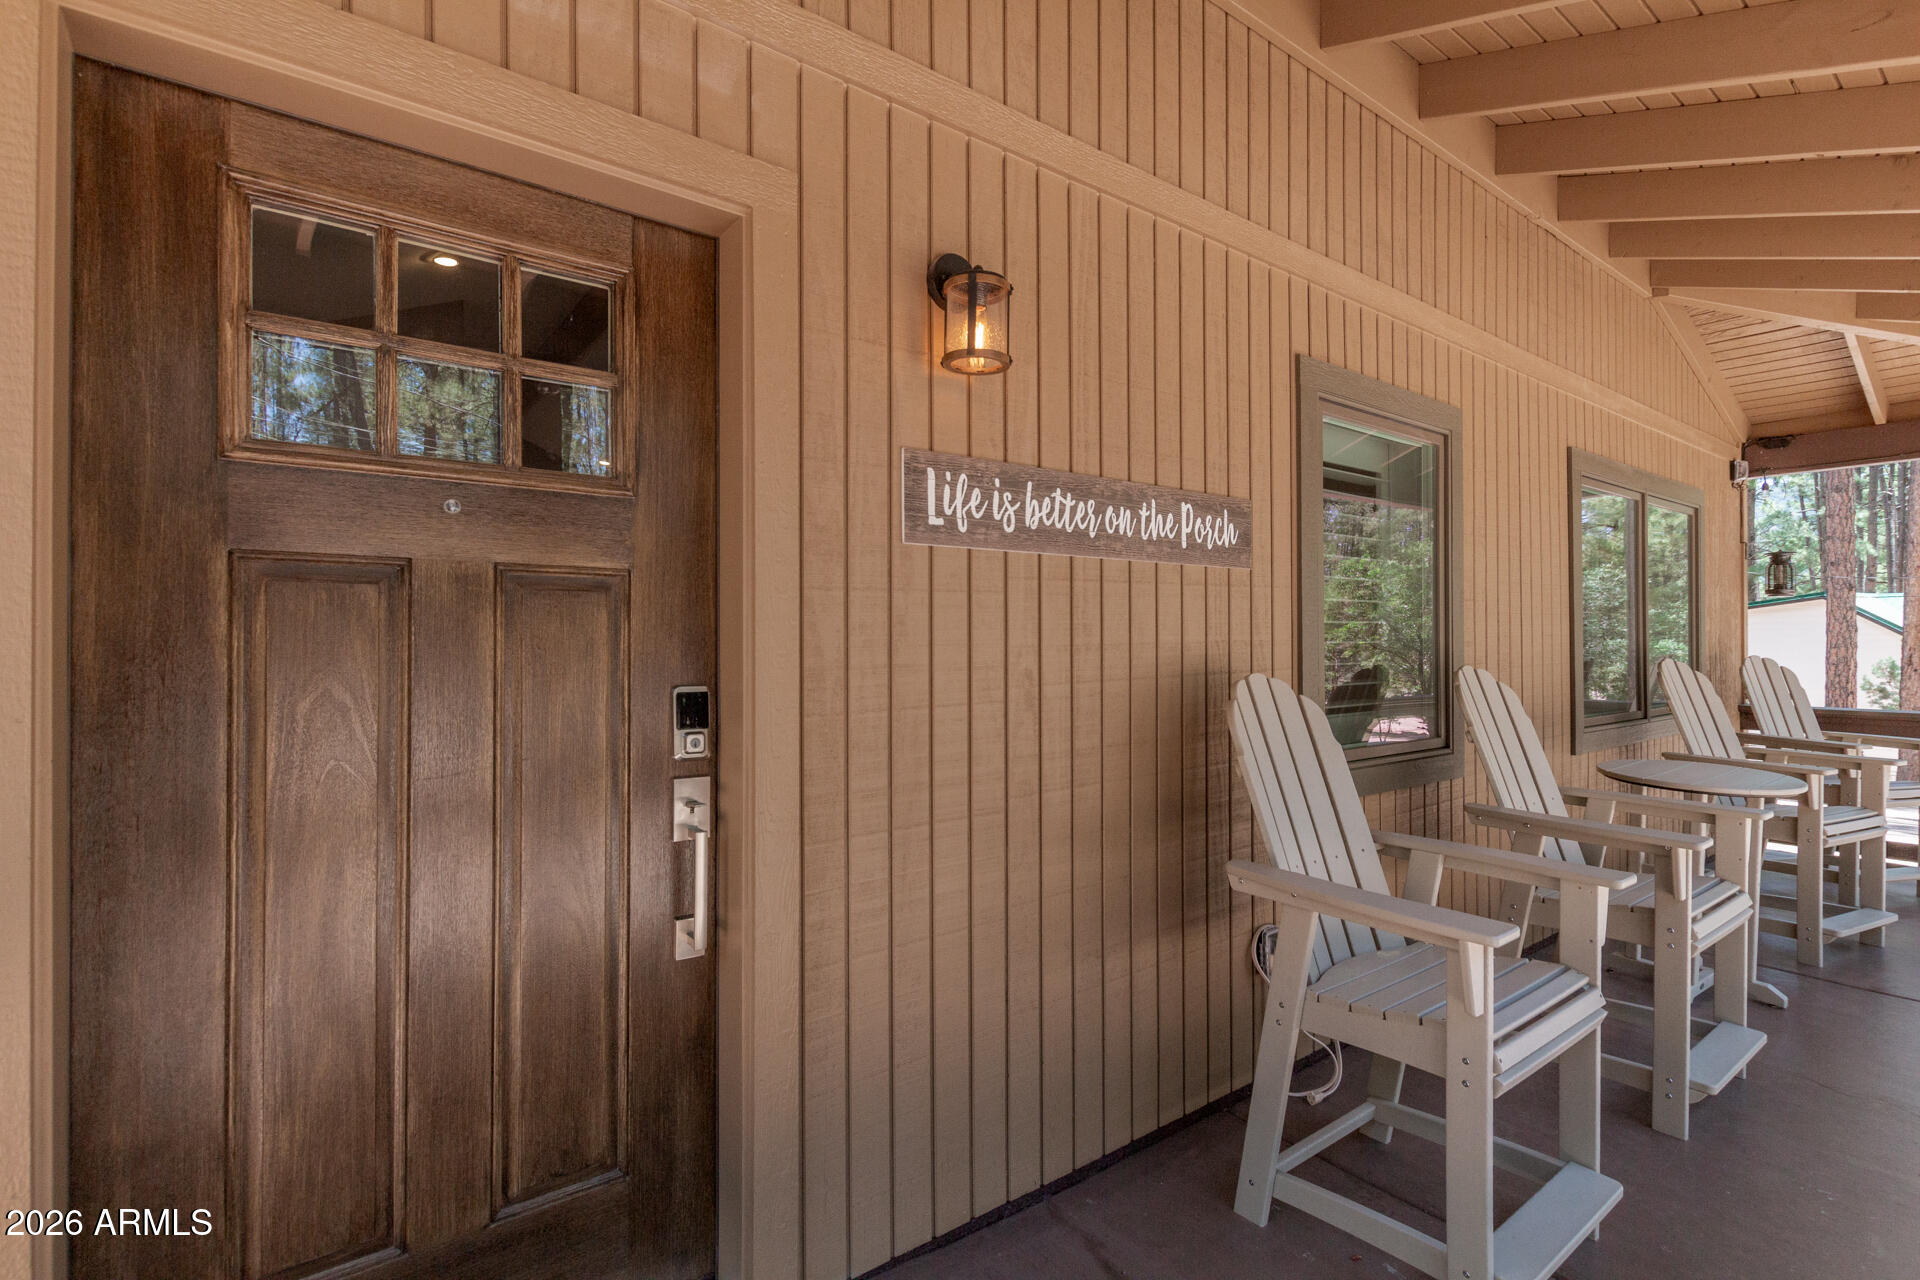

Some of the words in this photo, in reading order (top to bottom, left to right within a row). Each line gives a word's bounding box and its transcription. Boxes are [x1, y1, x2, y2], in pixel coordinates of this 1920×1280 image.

[926, 467, 988, 533] Life
[992, 478, 1020, 533] is
[1024, 481, 1102, 538] better
[1104, 506, 1136, 538] on
[1139, 498, 1179, 541] the
[1181, 501, 1239, 550] Porch
